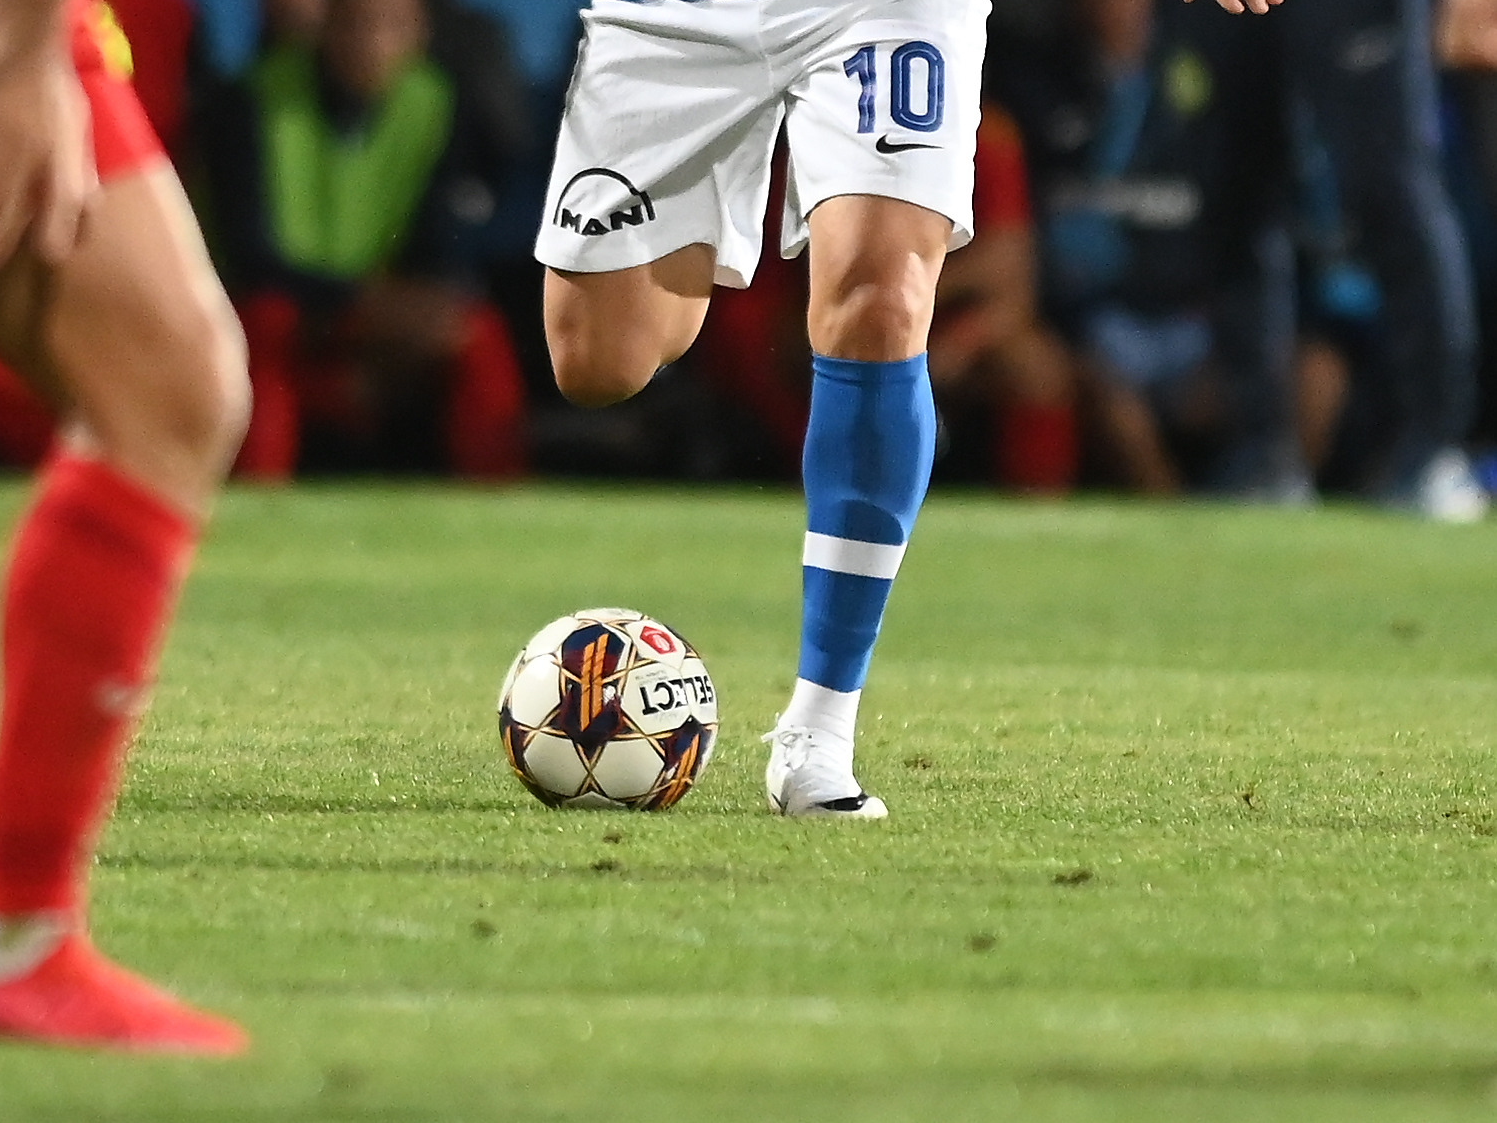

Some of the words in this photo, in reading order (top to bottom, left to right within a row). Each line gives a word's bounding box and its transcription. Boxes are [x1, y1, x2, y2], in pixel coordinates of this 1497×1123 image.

[842, 40, 946, 134] 10
[560, 204, 644, 236] MAN
[639, 675, 714, 716] SELECT
